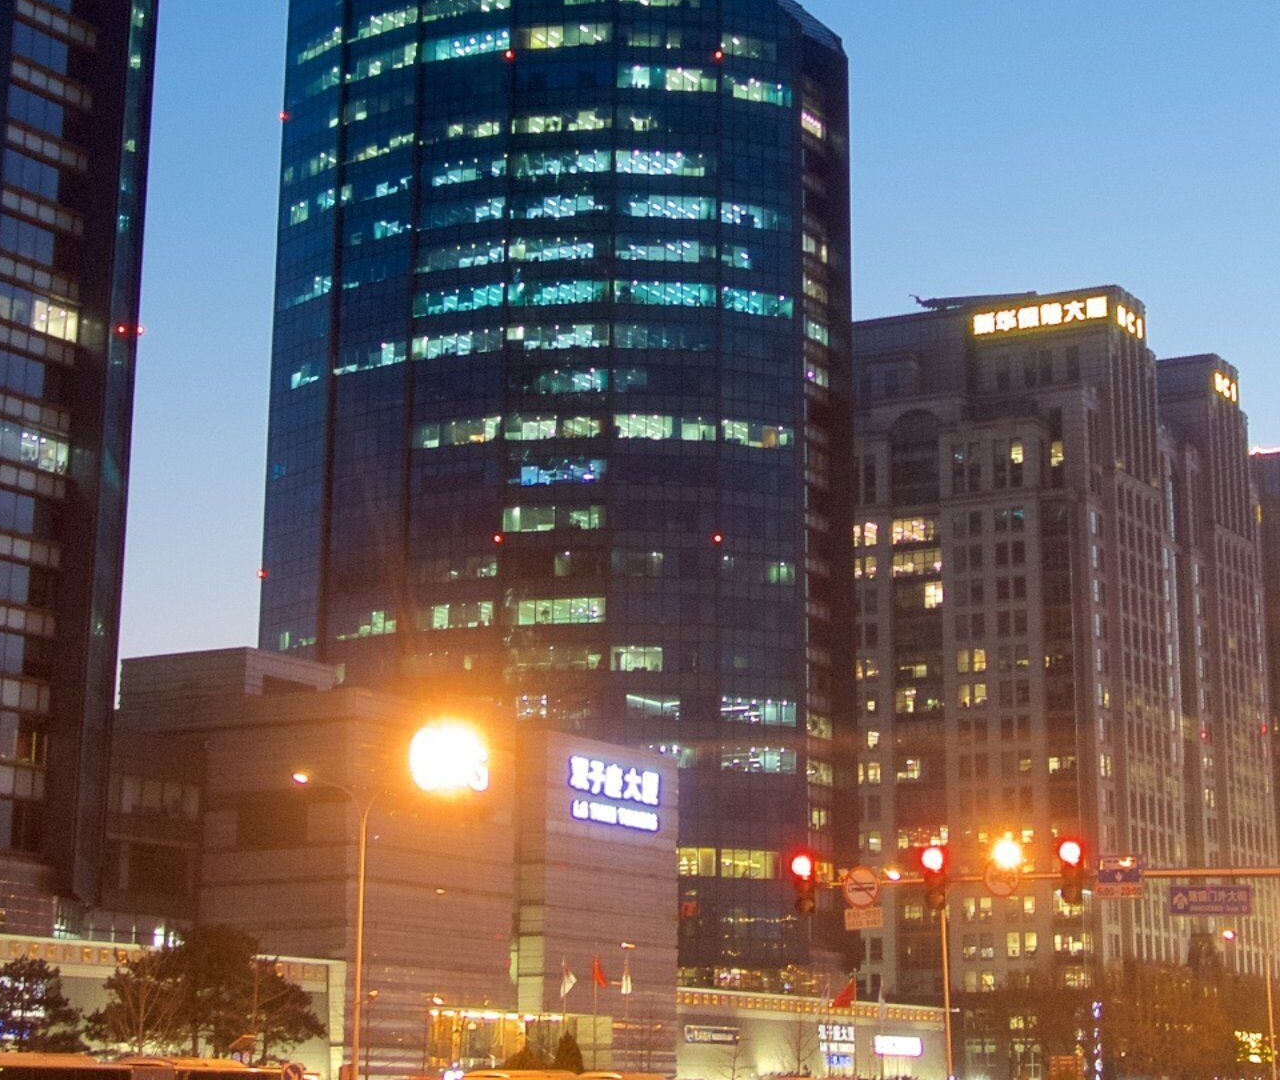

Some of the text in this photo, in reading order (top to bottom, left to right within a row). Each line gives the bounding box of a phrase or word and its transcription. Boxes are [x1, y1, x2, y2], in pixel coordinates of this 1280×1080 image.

[973, 295, 1108, 336] 新华保险大厦
